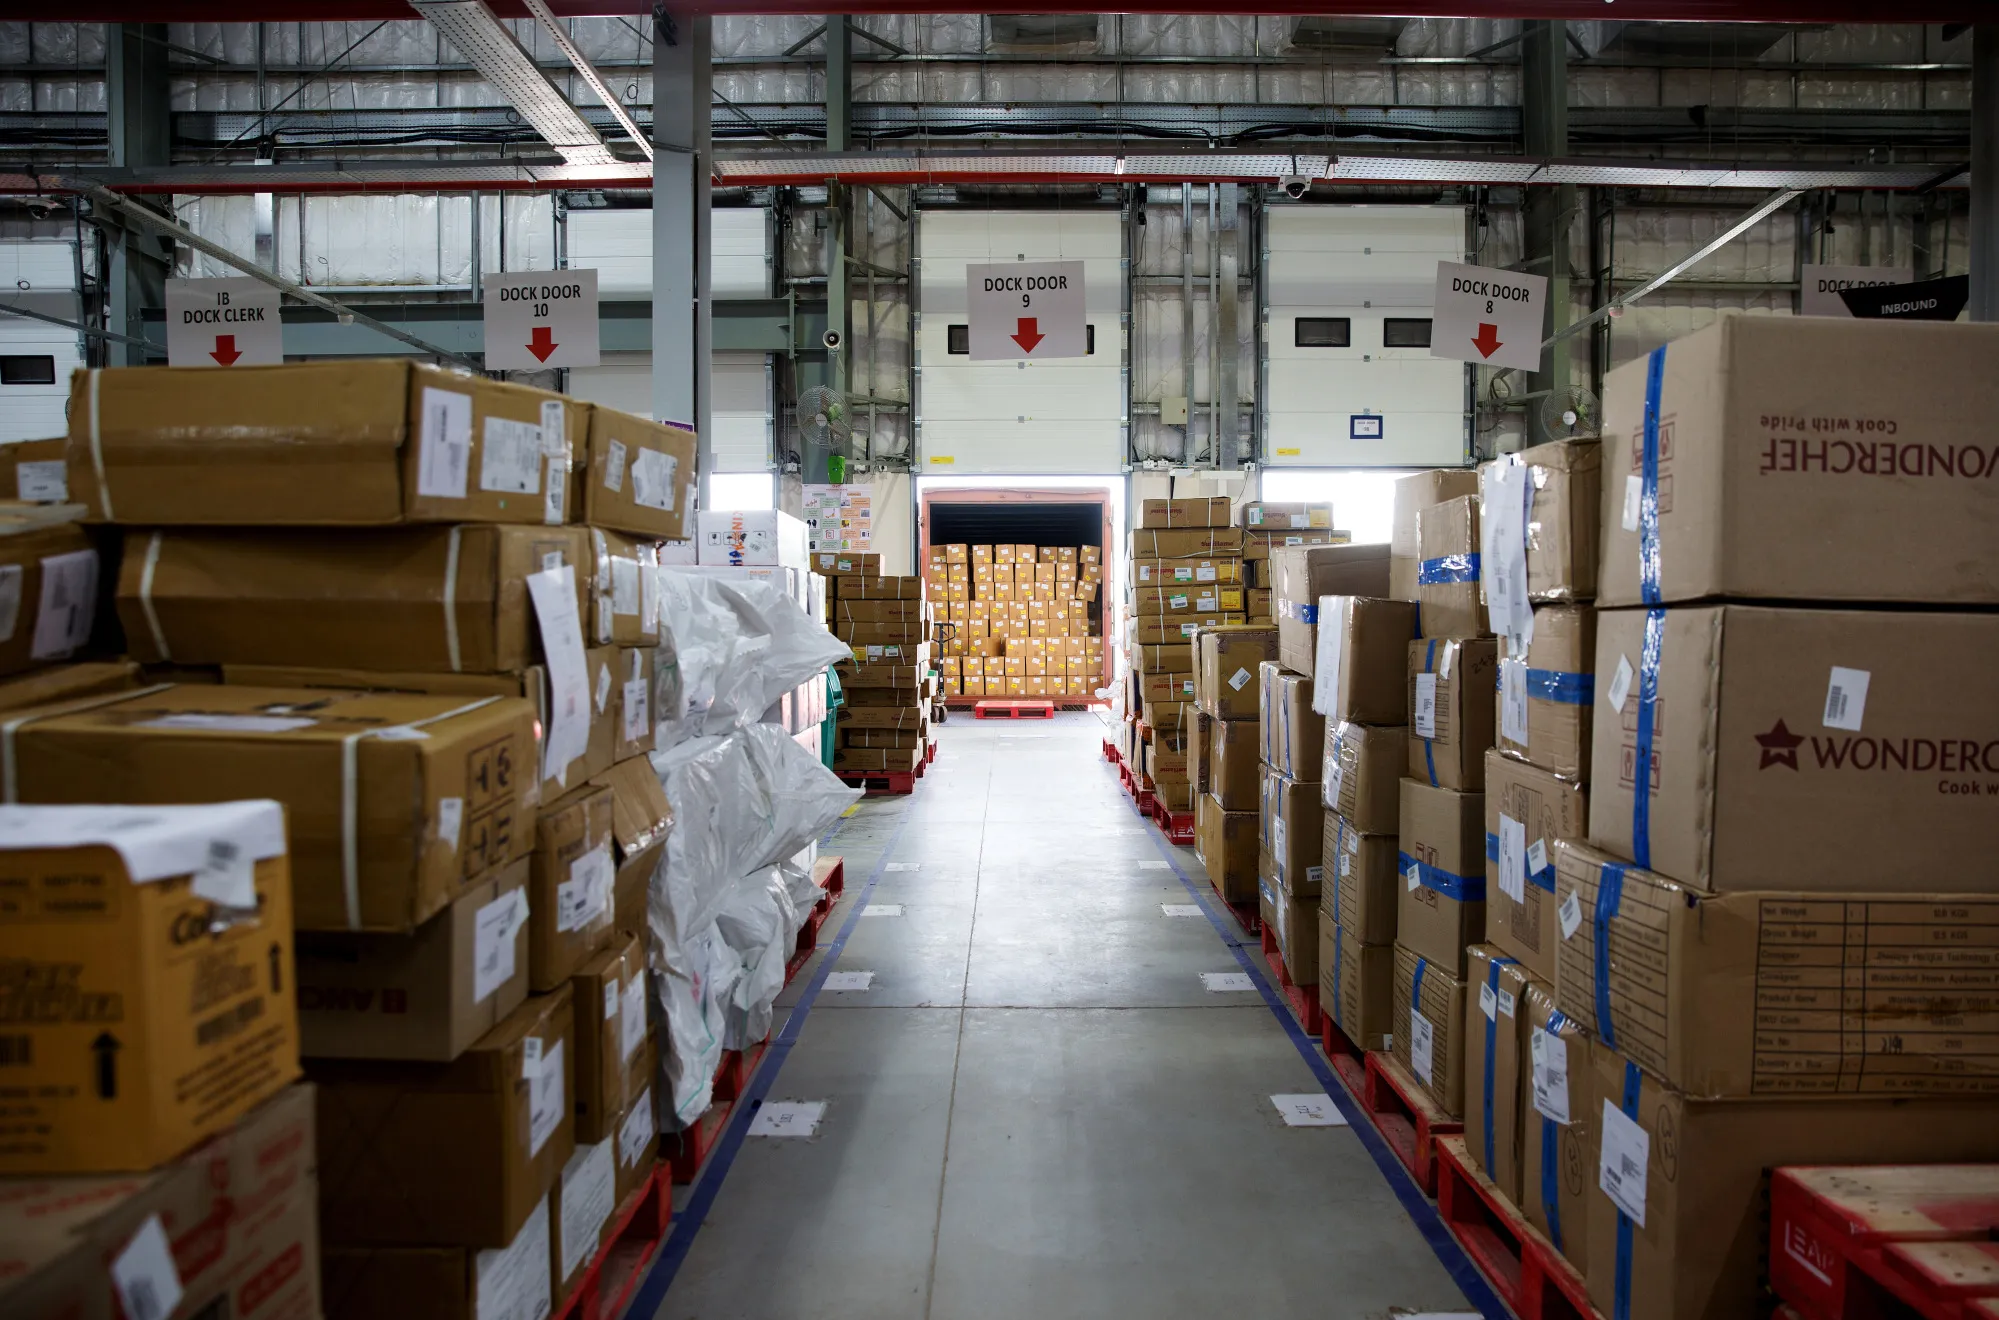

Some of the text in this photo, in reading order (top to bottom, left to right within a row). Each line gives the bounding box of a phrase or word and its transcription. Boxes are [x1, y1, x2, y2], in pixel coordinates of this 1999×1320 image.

[984, 275, 1068, 292] DOCK DOOR
[1452, 277, 1530, 303] DOCK DOOR
[1818, 279, 1854, 293] DOCK
[217, 292, 230, 306] IB
[500, 284, 581, 302] DOCK DOOR
[1022, 294, 1031, 308] 9
[533, 303, 549, 317] 10
[1485, 300, 1494, 314] 8
[1880, 298, 1938, 315] INBOUND
[183, 307, 266, 324] DOCK CLERK
[1760, 415, 1898, 435] Cook with Pride
[1937, 780, 1981, 796] Cook
